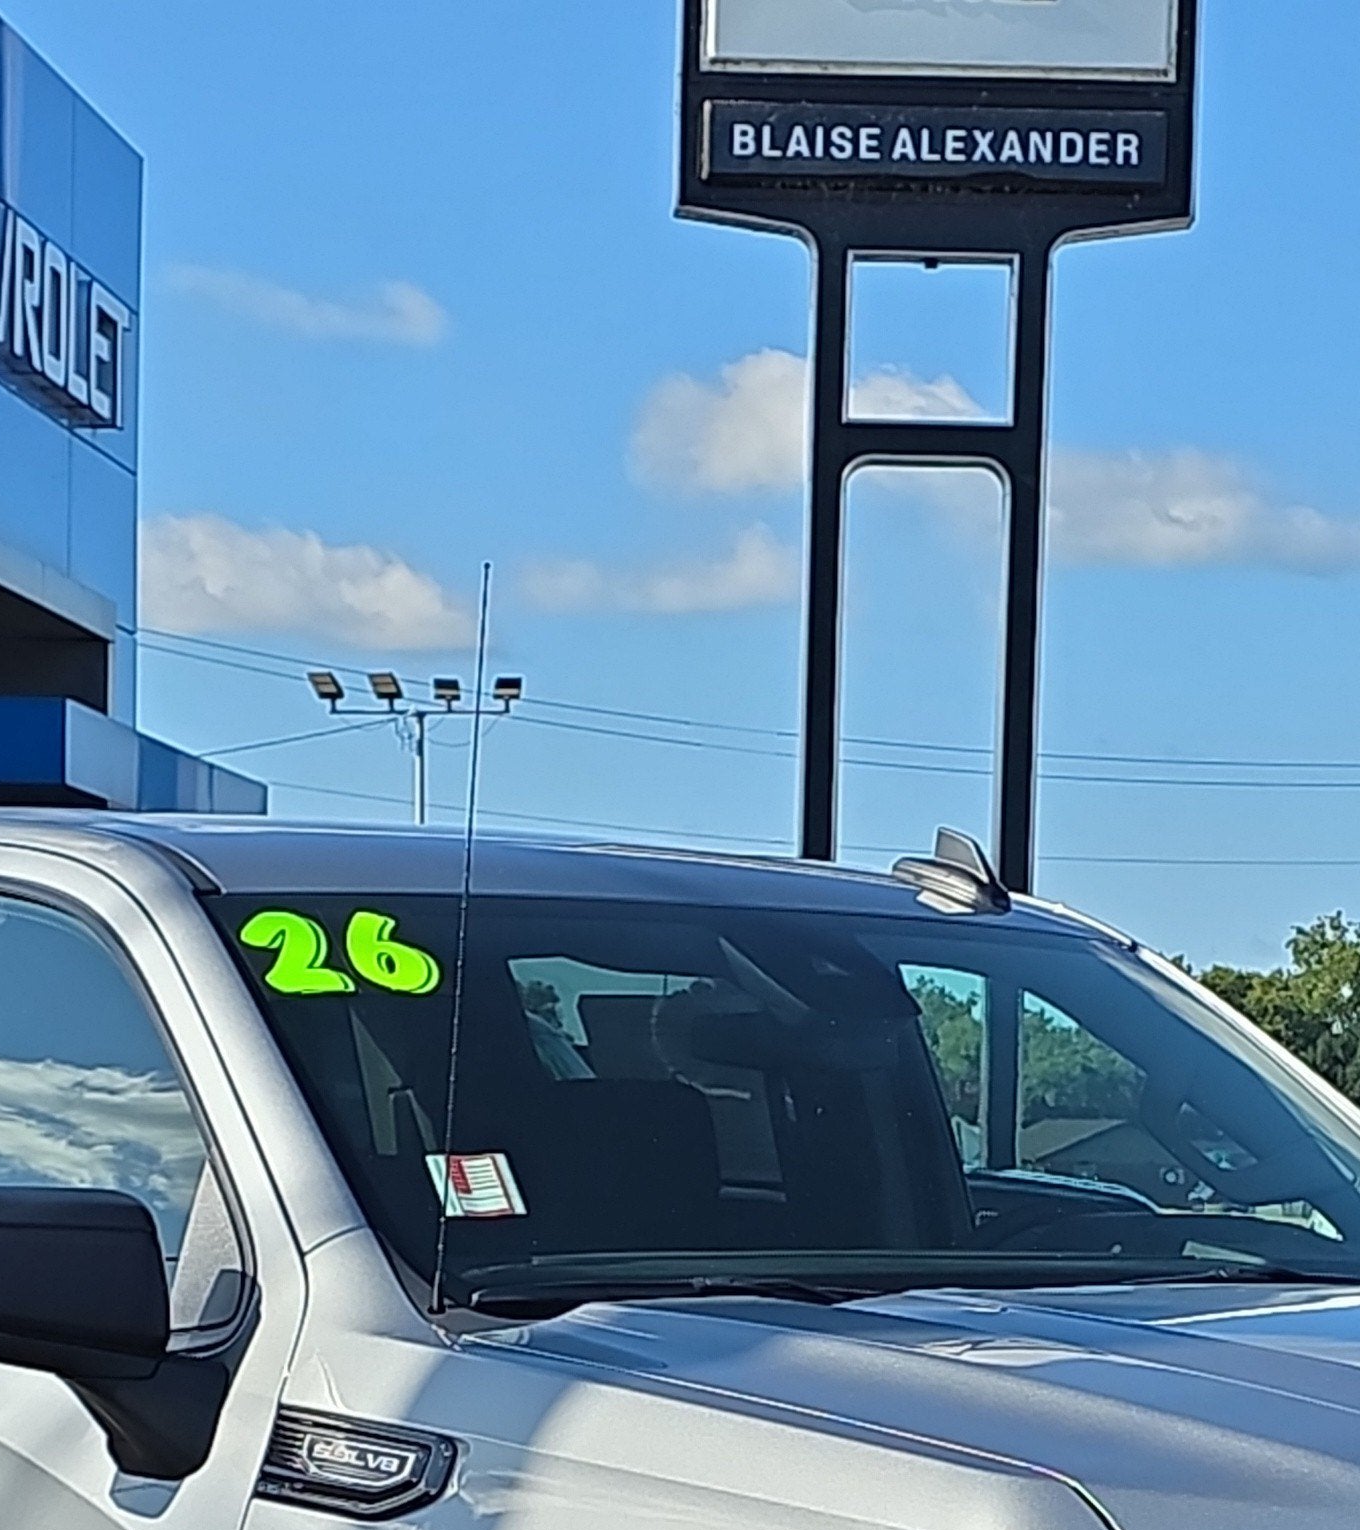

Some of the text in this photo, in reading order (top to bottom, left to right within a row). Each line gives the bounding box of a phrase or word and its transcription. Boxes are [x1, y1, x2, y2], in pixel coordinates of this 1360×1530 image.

[731, 123, 1140, 166] BLAISE ALEXANDER
[240, 910, 440, 995] 26
